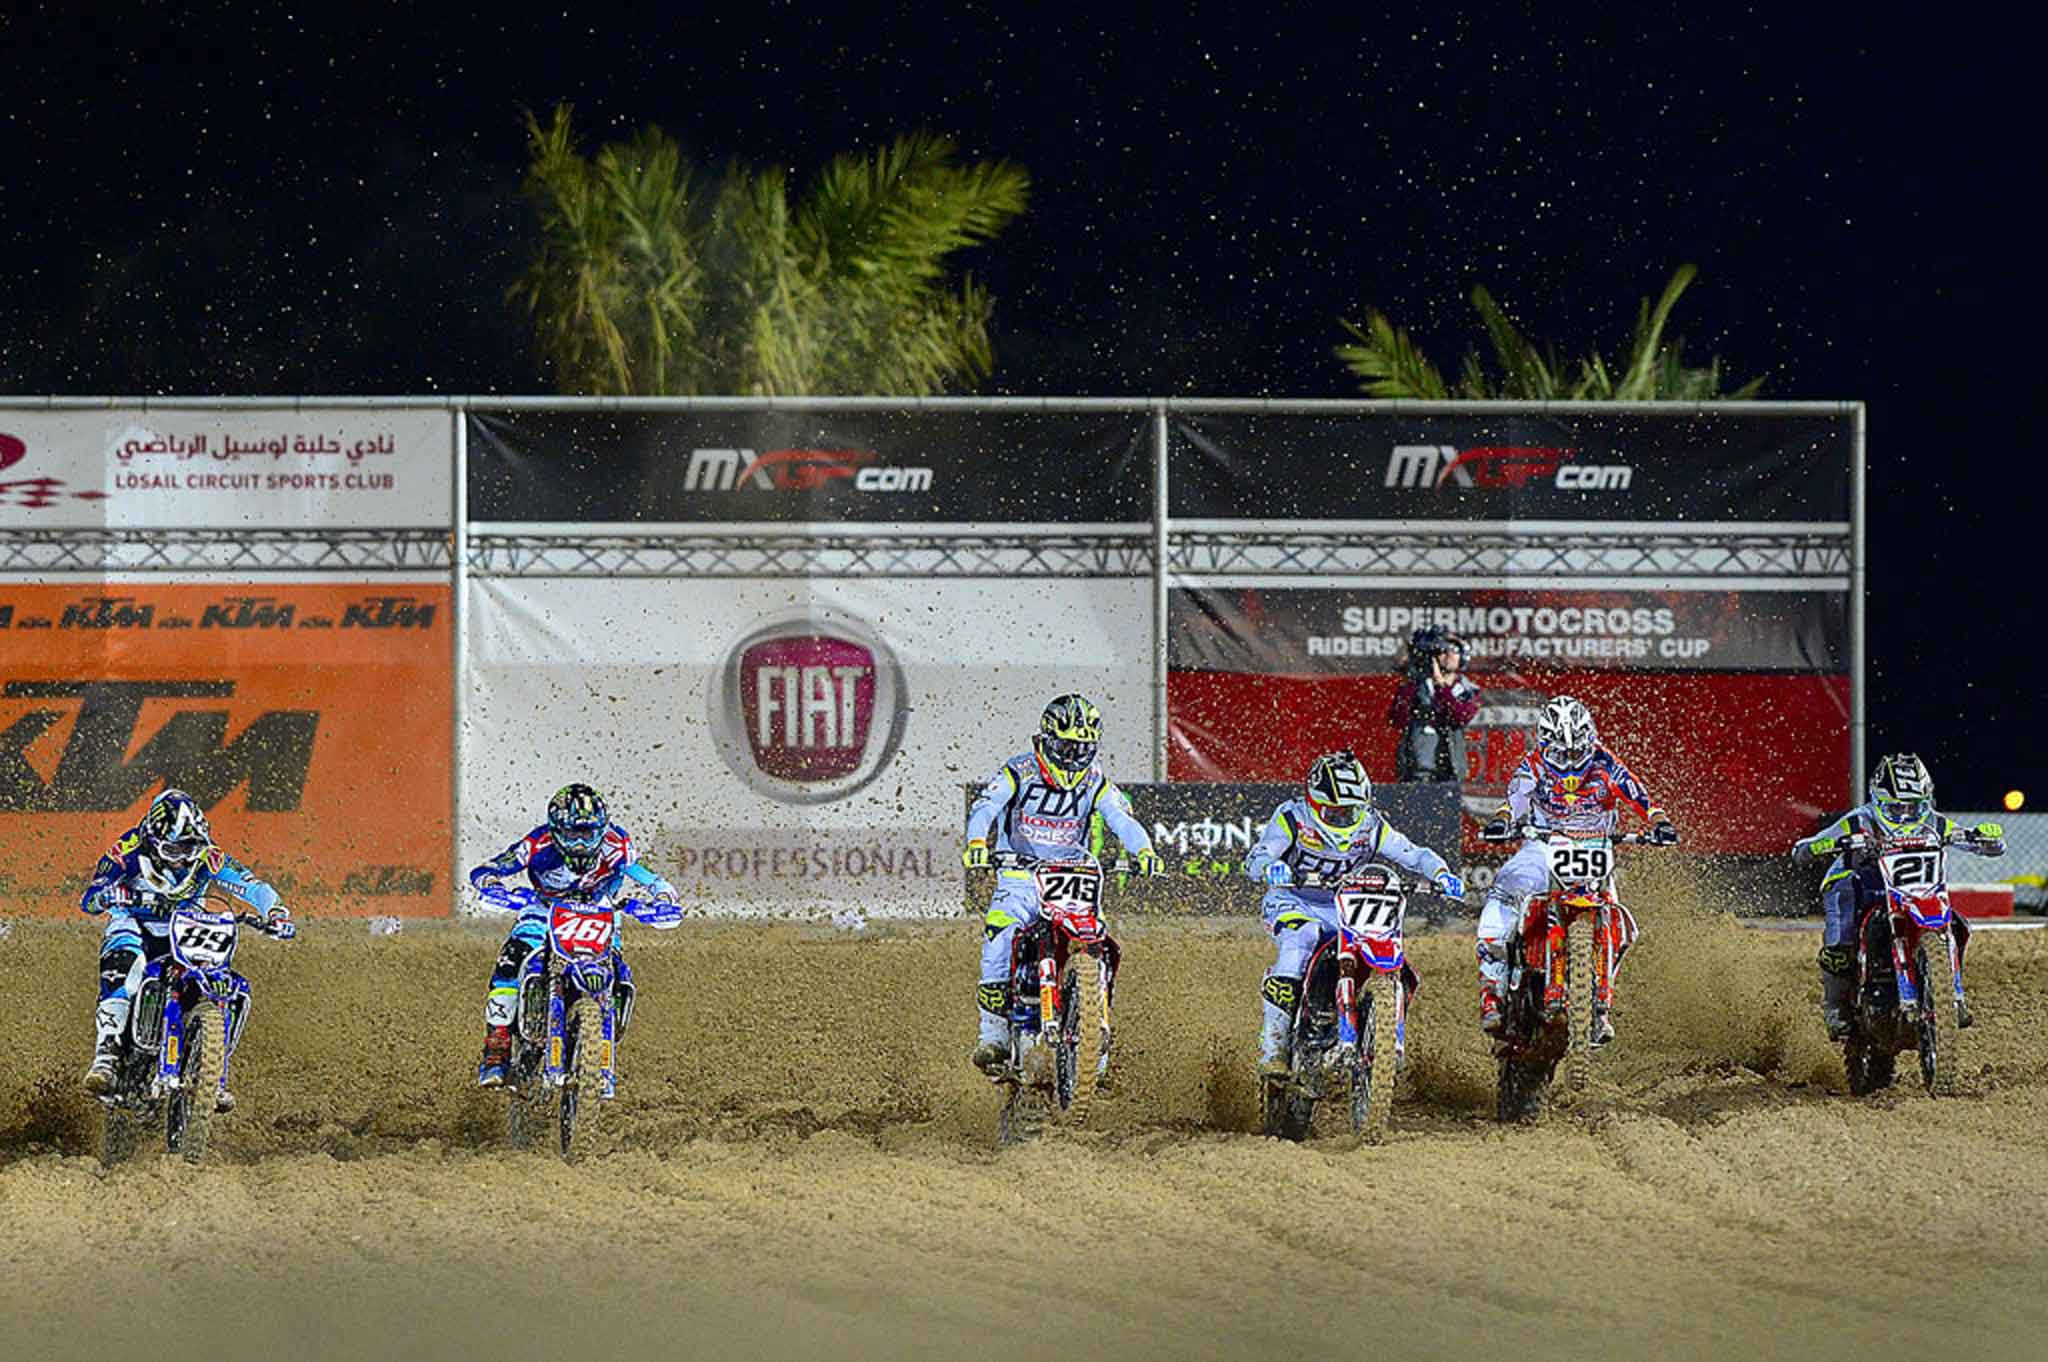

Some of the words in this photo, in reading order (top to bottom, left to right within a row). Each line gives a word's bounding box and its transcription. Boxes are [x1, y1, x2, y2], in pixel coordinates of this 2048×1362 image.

[115, 434, 208, 466] الرياضي
[212, 434, 288, 462] لوسيل
[293, 433, 341, 461] حلبة
[346, 434, 394, 467] نادي
[115, 473, 180, 490] LOSAIL
[186, 473, 260, 490] CIRCUIT
[266, 473, 339, 490] SPORTS
[344, 473, 394, 490] CLUB
[58, 597, 155, 630] KTM
[200, 597, 297, 630] KTM
[340, 597, 436, 630] KTM
[1342, 607, 1676, 635] SUPERMOTOCROSS
[1470, 637, 1652, 658] NUFACTURERS'
[1659, 638, 1711, 658] CUP
[756, 665, 866, 748] FIAT
[678, 848, 944, 880] PROFESSIONAL
[1553, 849, 1607, 878] 259
[1893, 854, 1937, 887] 21
[1043, 875, 1098, 903] 243
[1348, 897, 1399, 927] 777
[177, 926, 233, 953] 89
[554, 917, 612, 945] 461
